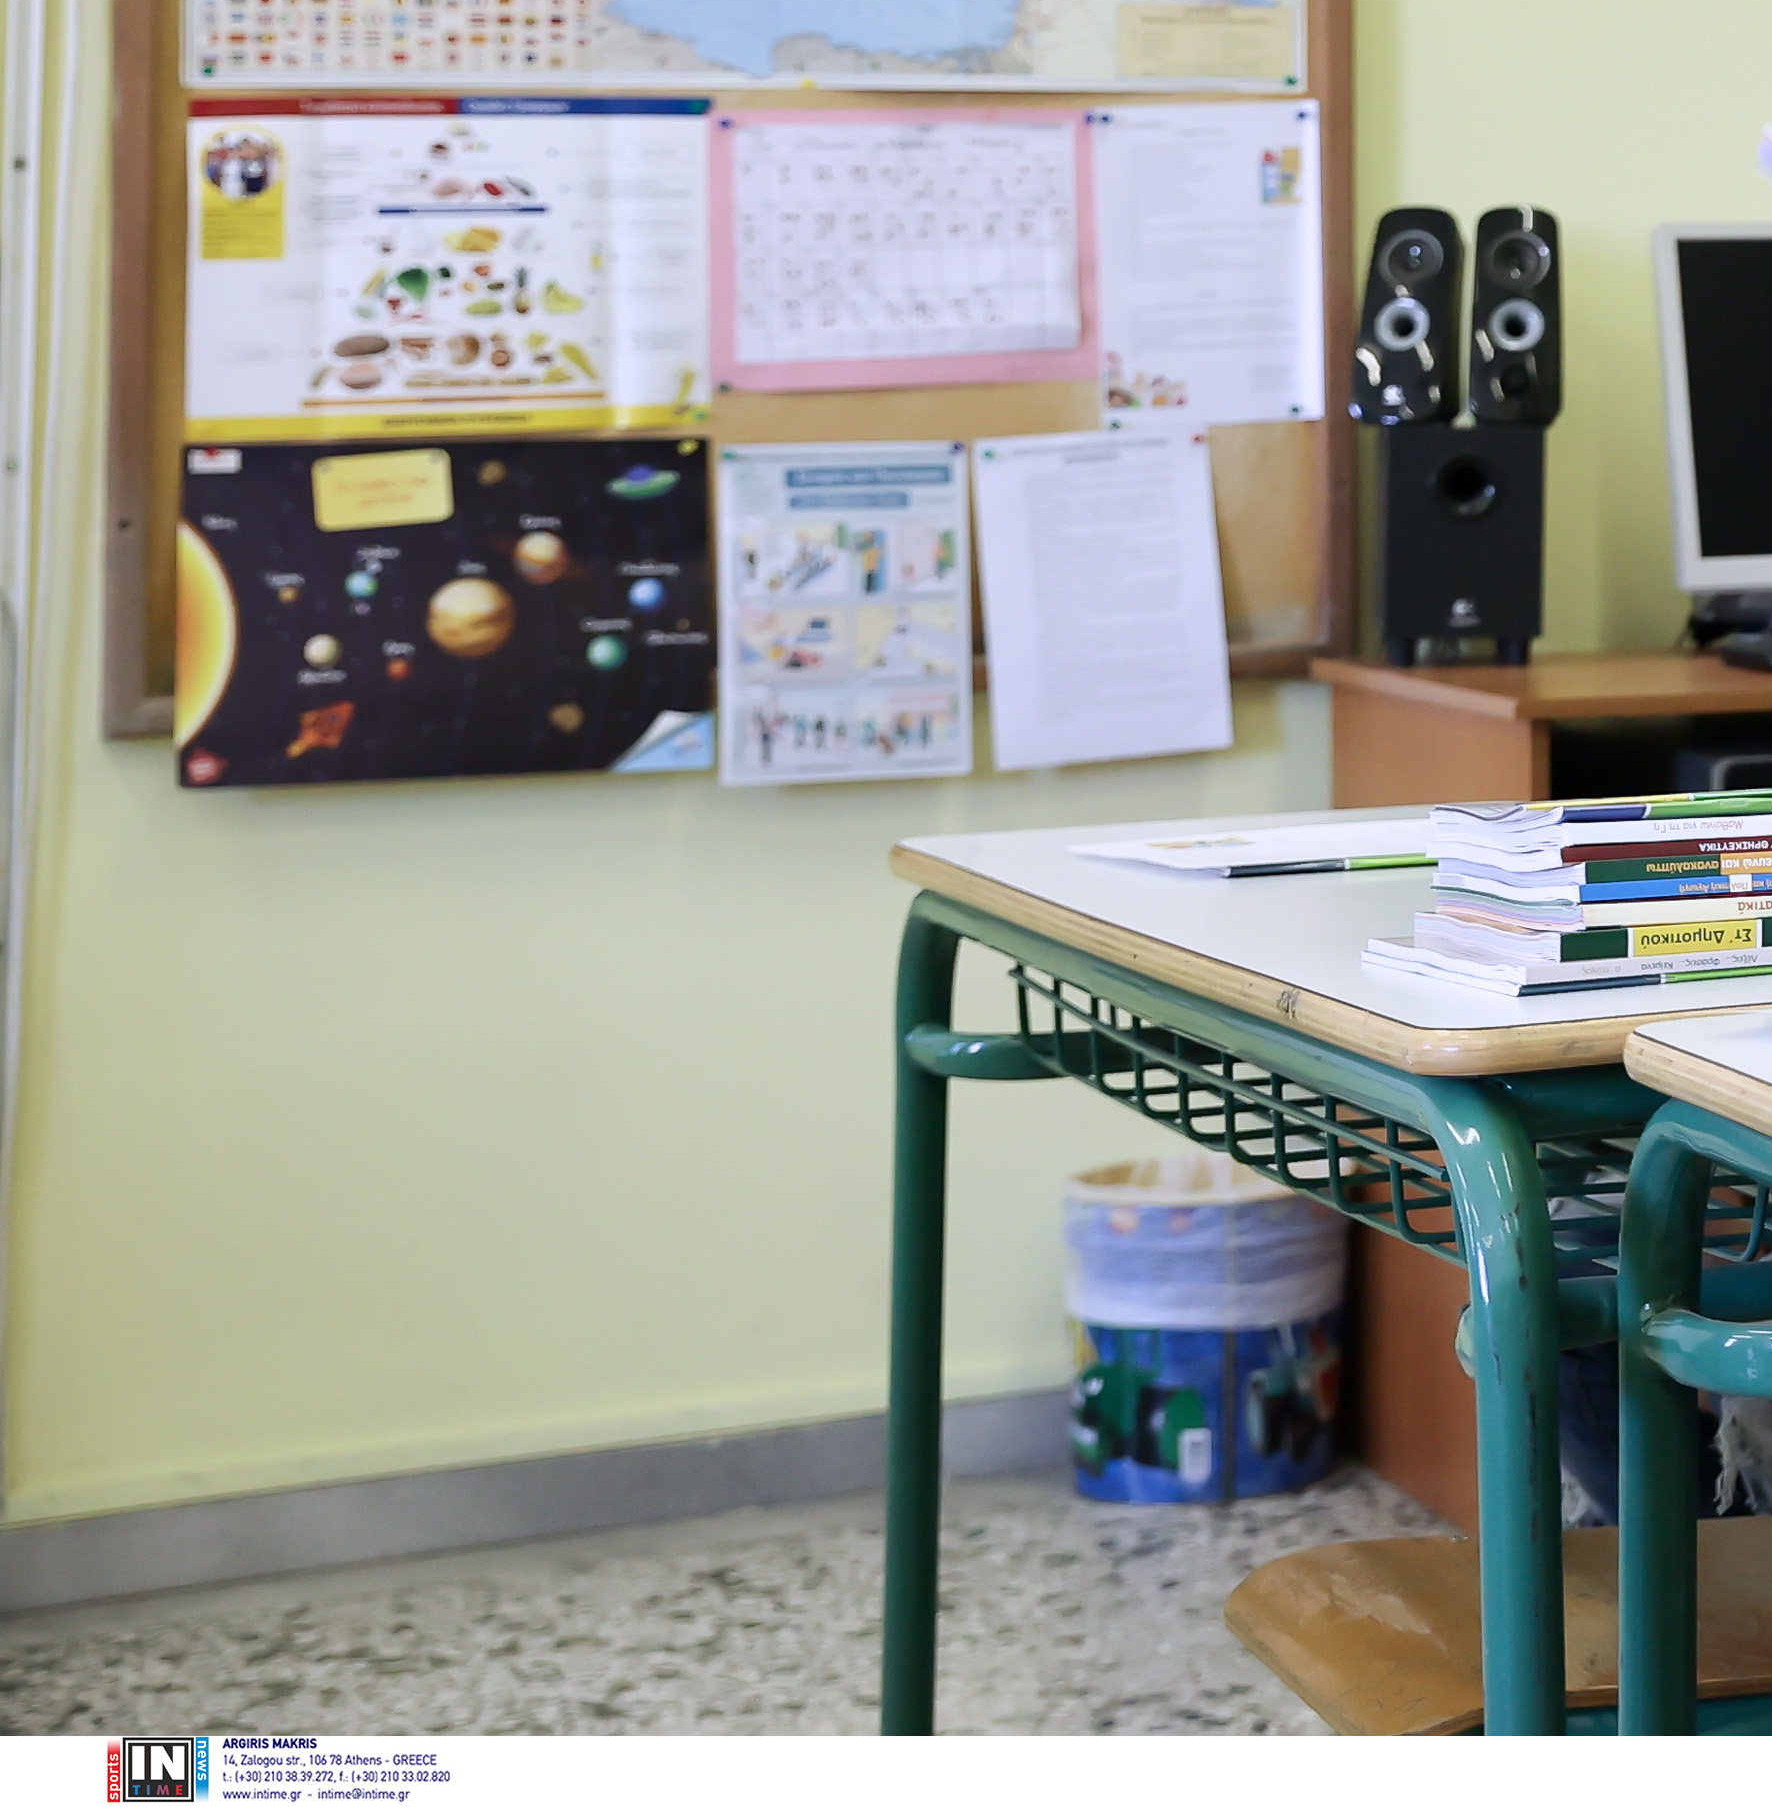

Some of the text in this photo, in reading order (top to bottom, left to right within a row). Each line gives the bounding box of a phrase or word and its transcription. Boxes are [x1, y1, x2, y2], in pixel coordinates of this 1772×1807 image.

[1654, 820, 1743, 833] Μαθαίνω για τη Γη
[1699, 839, 1769, 852] ΘΡΗΣΚΕΥΤΙΚΑ
[1646, 860, 1719, 873] ανακαλύπτω
[1722, 859, 1740, 870] και
[1641, 930, 1725, 948] Δημοτικού
